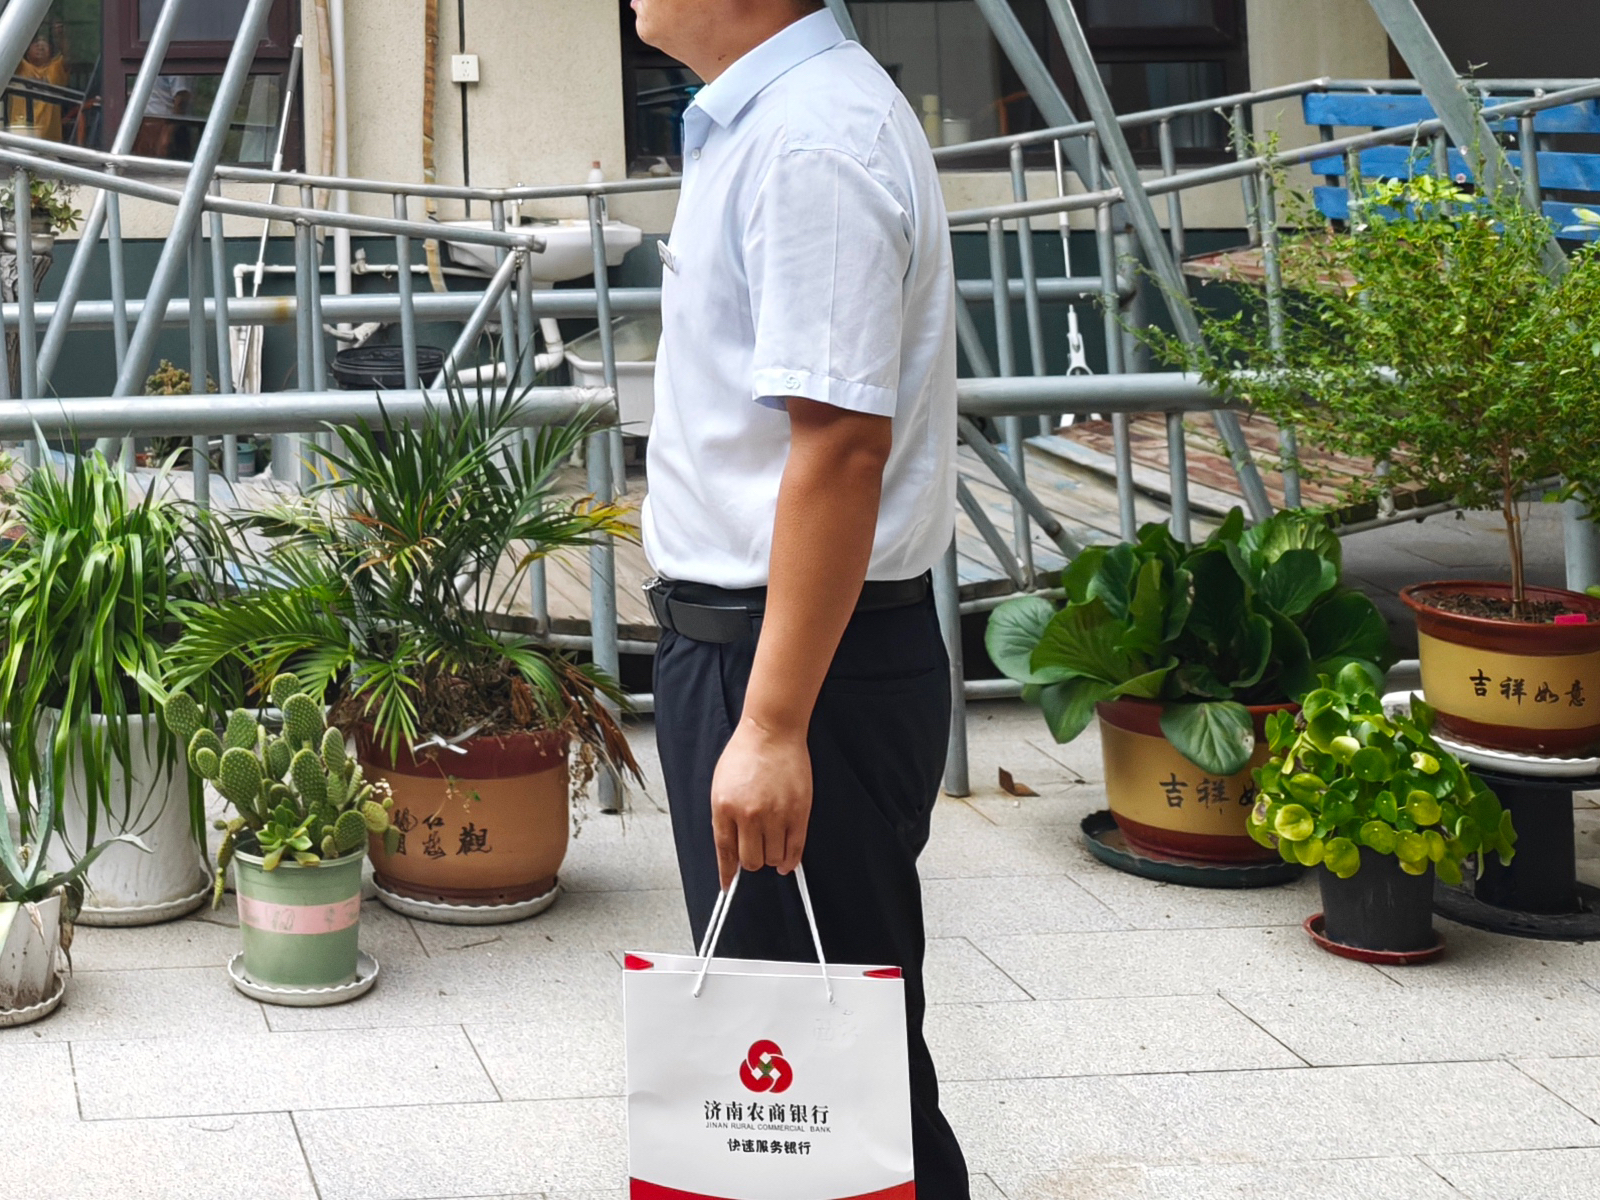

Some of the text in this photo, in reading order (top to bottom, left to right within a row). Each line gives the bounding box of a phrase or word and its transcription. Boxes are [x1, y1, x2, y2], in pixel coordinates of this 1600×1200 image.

[1469, 669, 1585, 707] 吉祥如意
[704, 1100, 829, 1124] 济南农商银行
[757, 1124, 805, 1132] COMMERCIAL
[727, 1138, 811, 1155] 快速服务银行
